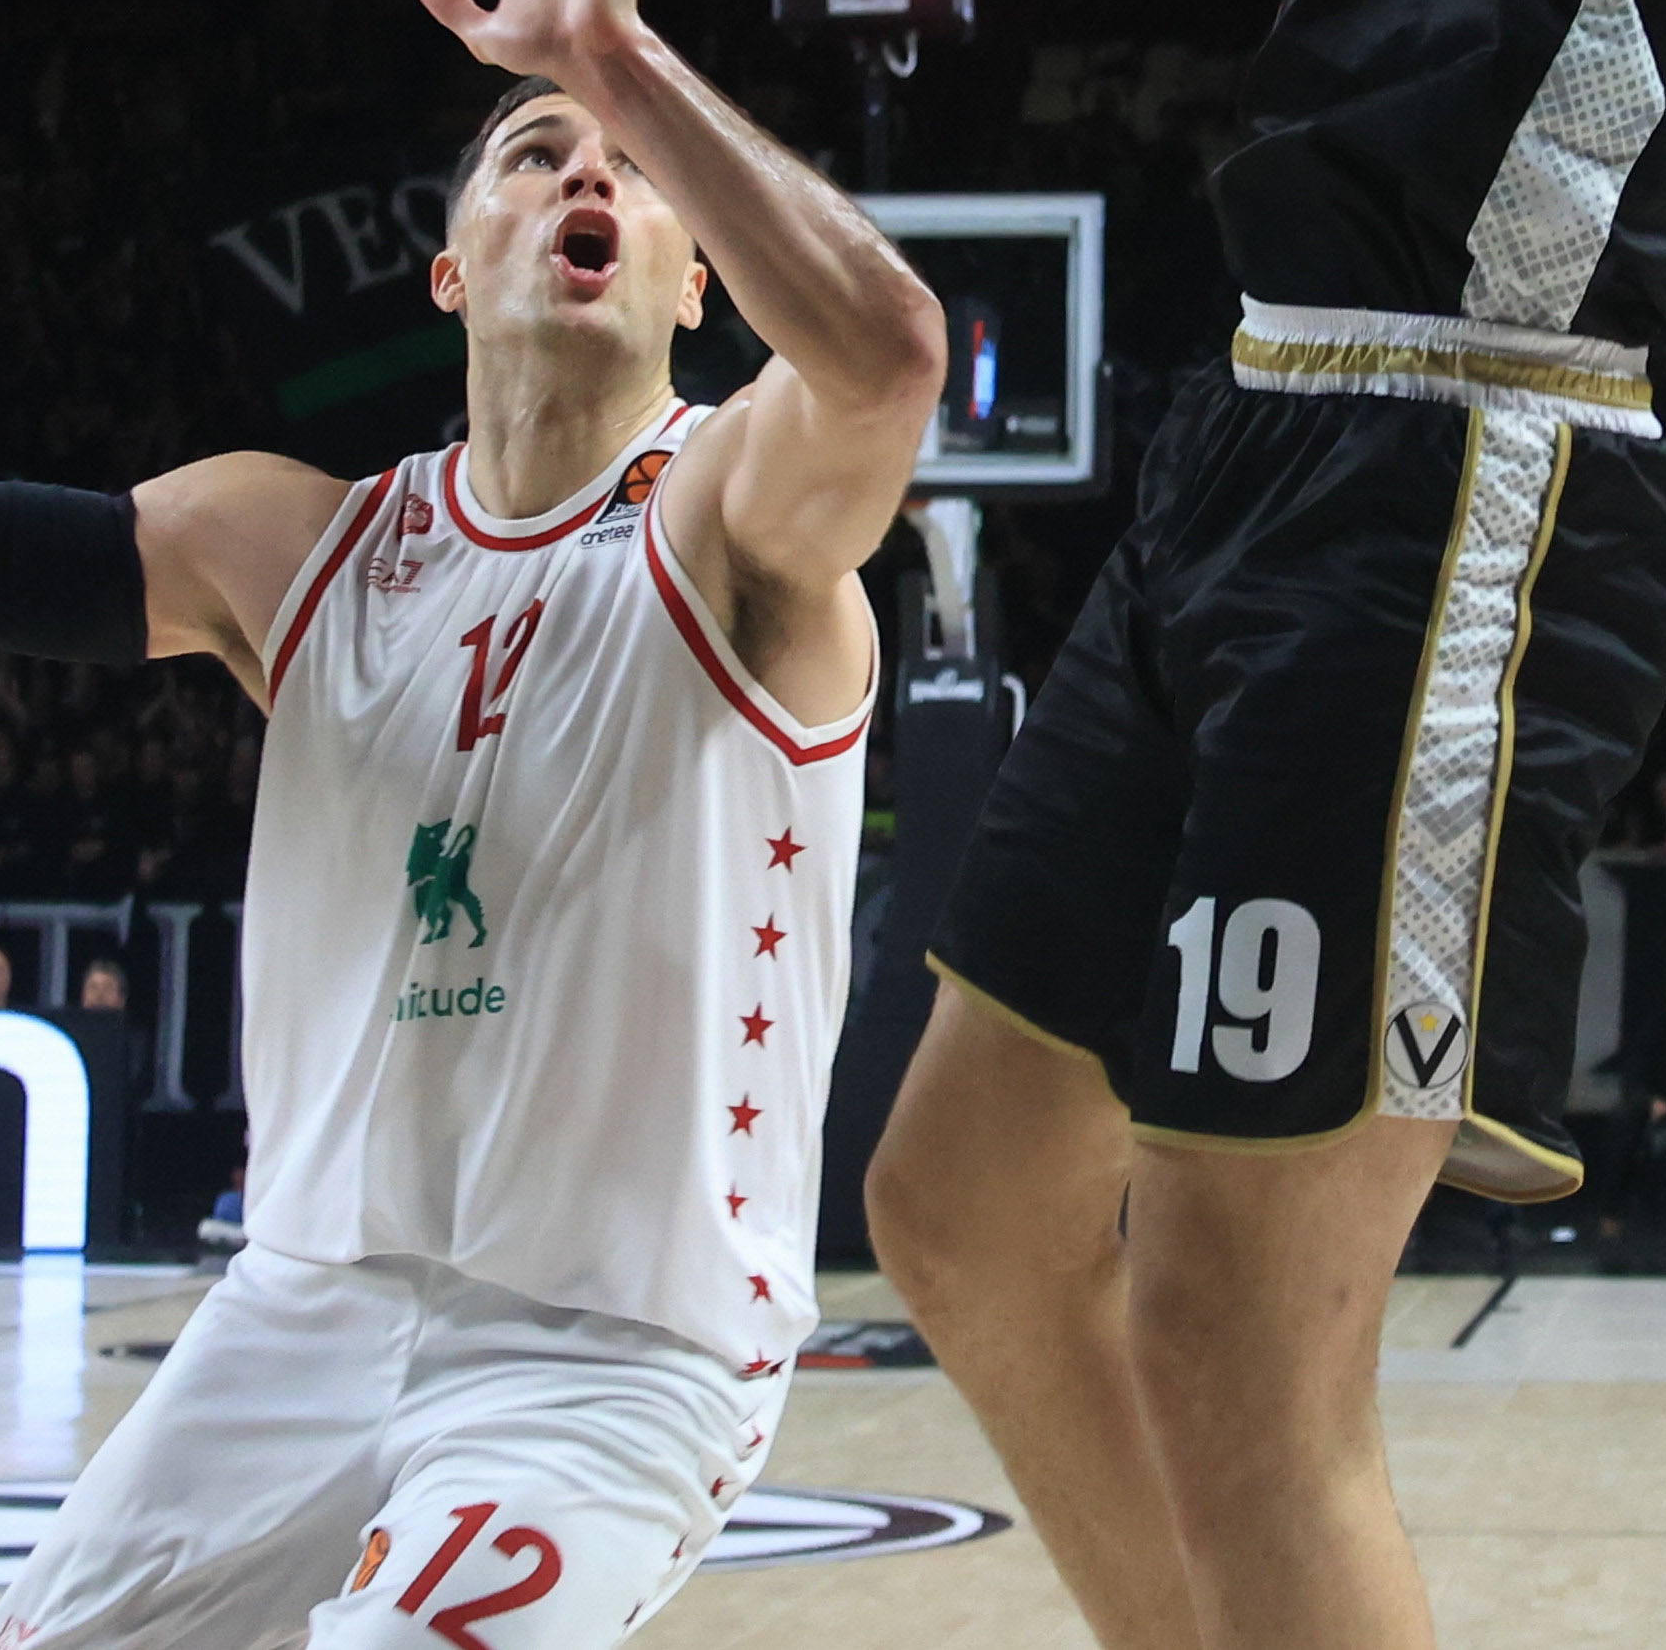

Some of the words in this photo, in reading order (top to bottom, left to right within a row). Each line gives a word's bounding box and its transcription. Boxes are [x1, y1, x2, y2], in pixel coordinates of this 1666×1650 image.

[459, 598, 545, 752] 12
[1167, 895, 1322, 1083] 19
[394, 1500, 563, 1650] 12
